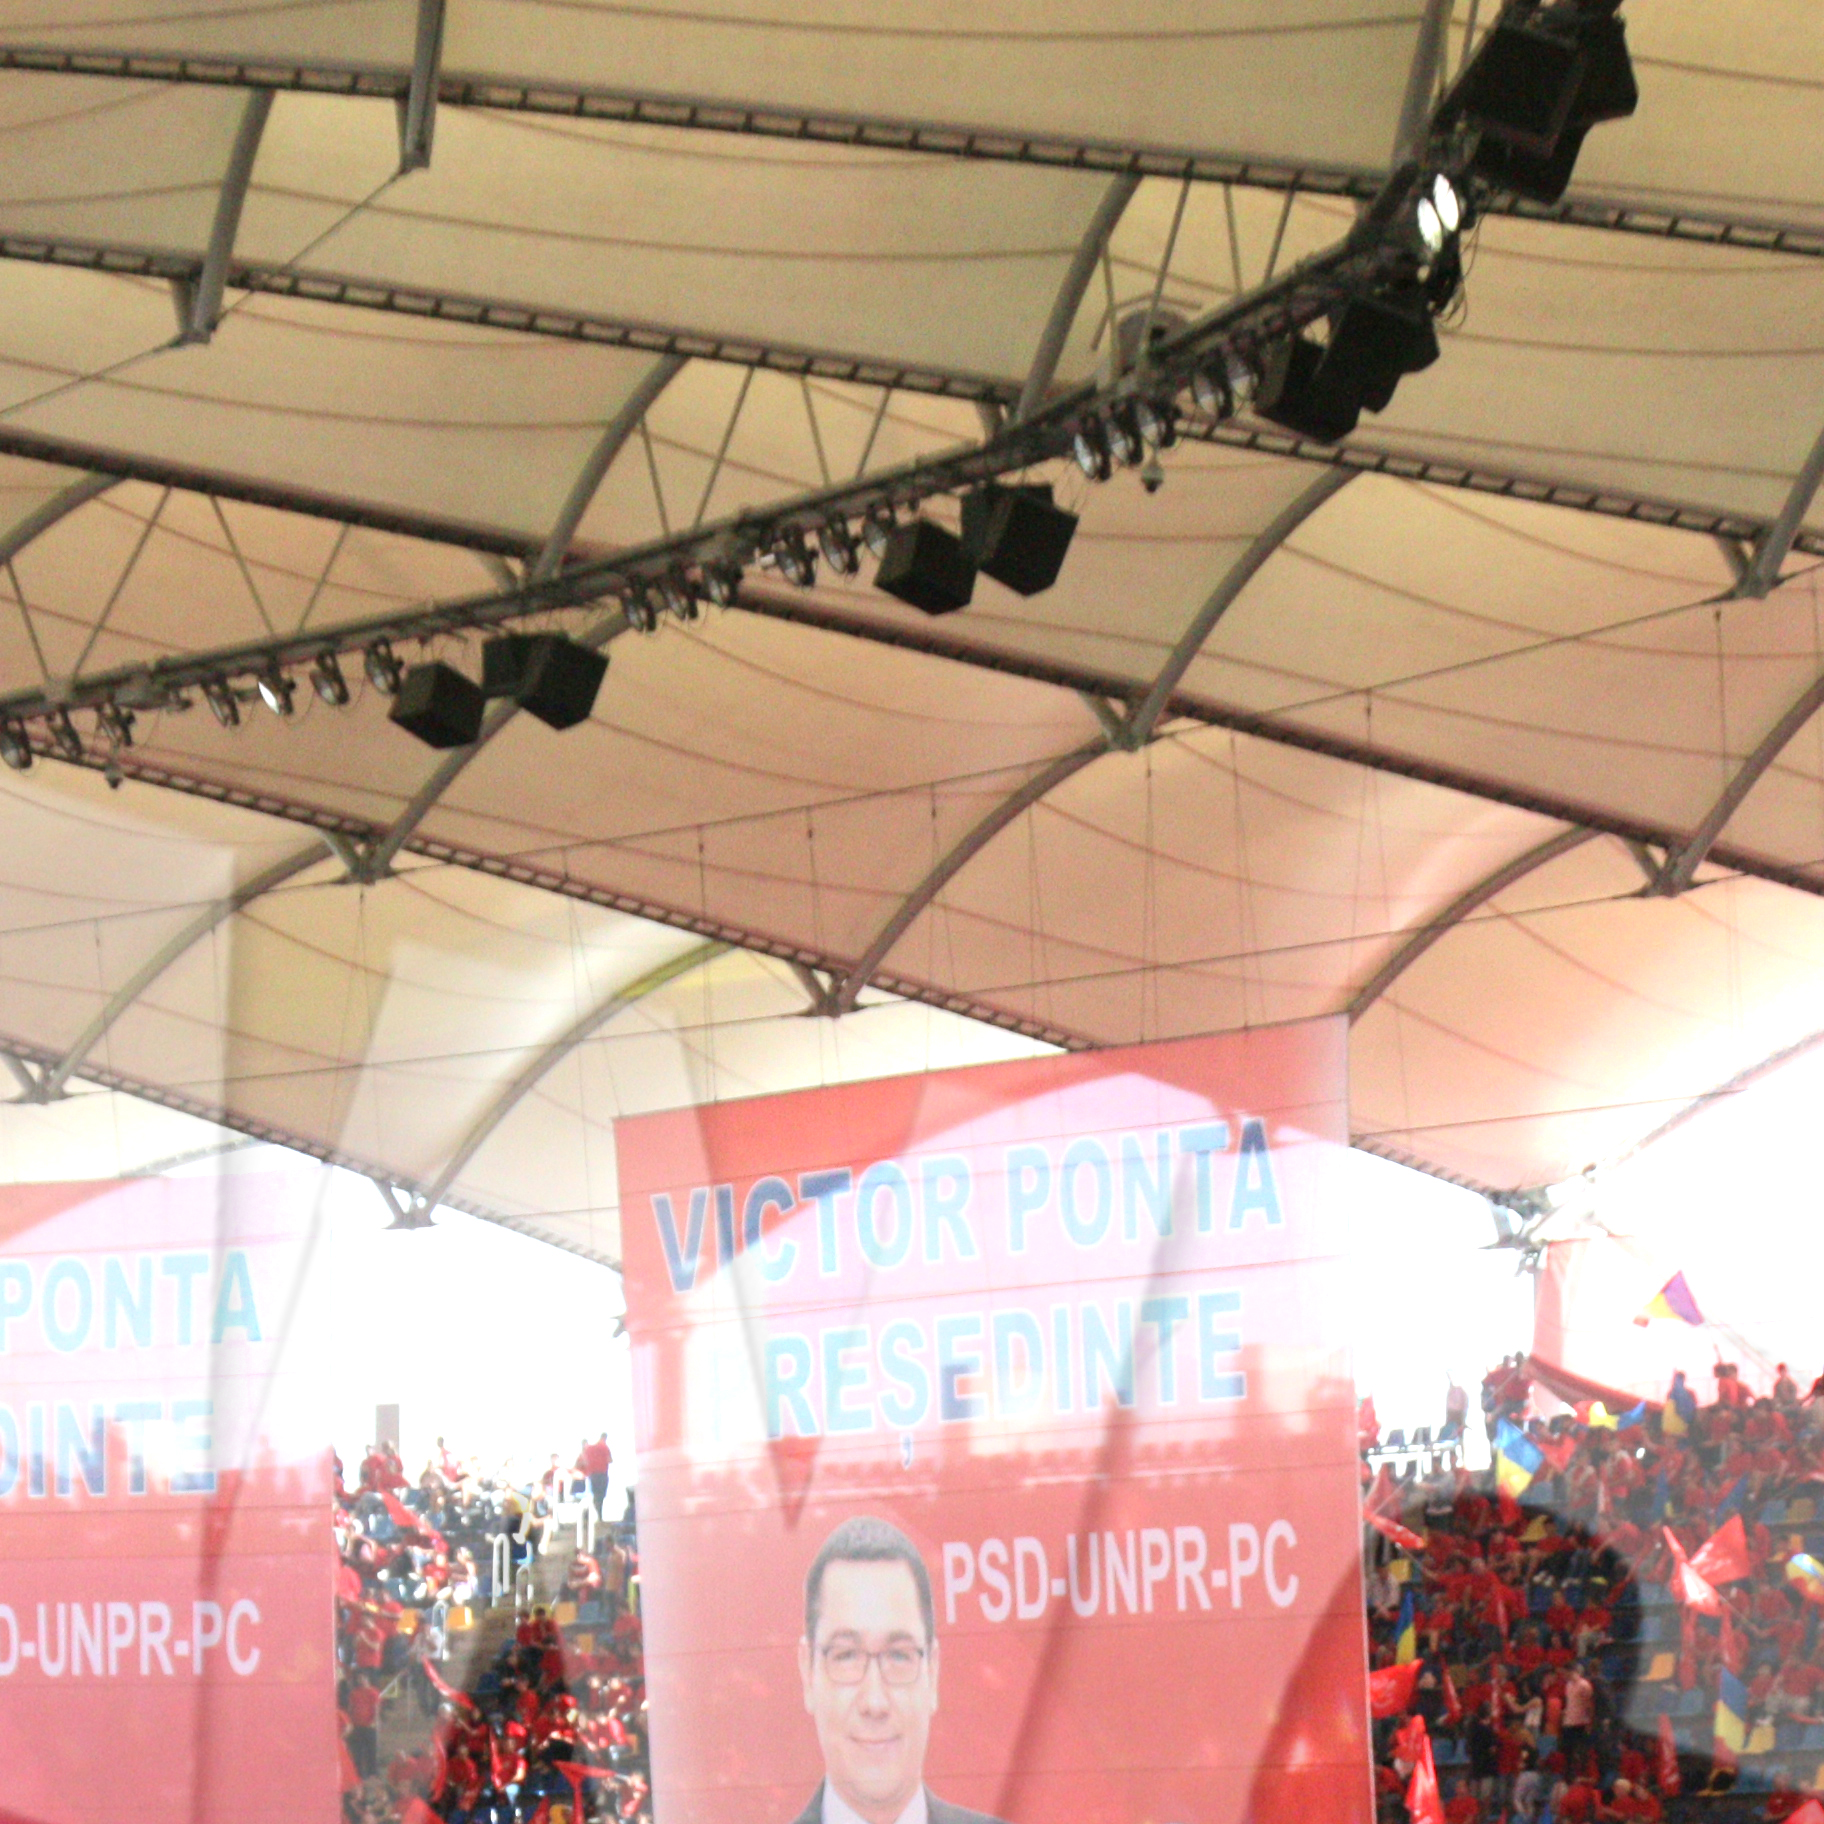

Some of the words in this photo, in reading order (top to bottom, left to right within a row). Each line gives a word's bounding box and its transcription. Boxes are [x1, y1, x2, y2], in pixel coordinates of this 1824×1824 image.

[651, 1154, 978, 1293] VICTOR
[1006, 1117, 1284, 1253] PONTA
[710, 1290, 1246, 1467] REȘEDINTE
[942, 1520, 1300, 1623] PSD-UNPR-PC
